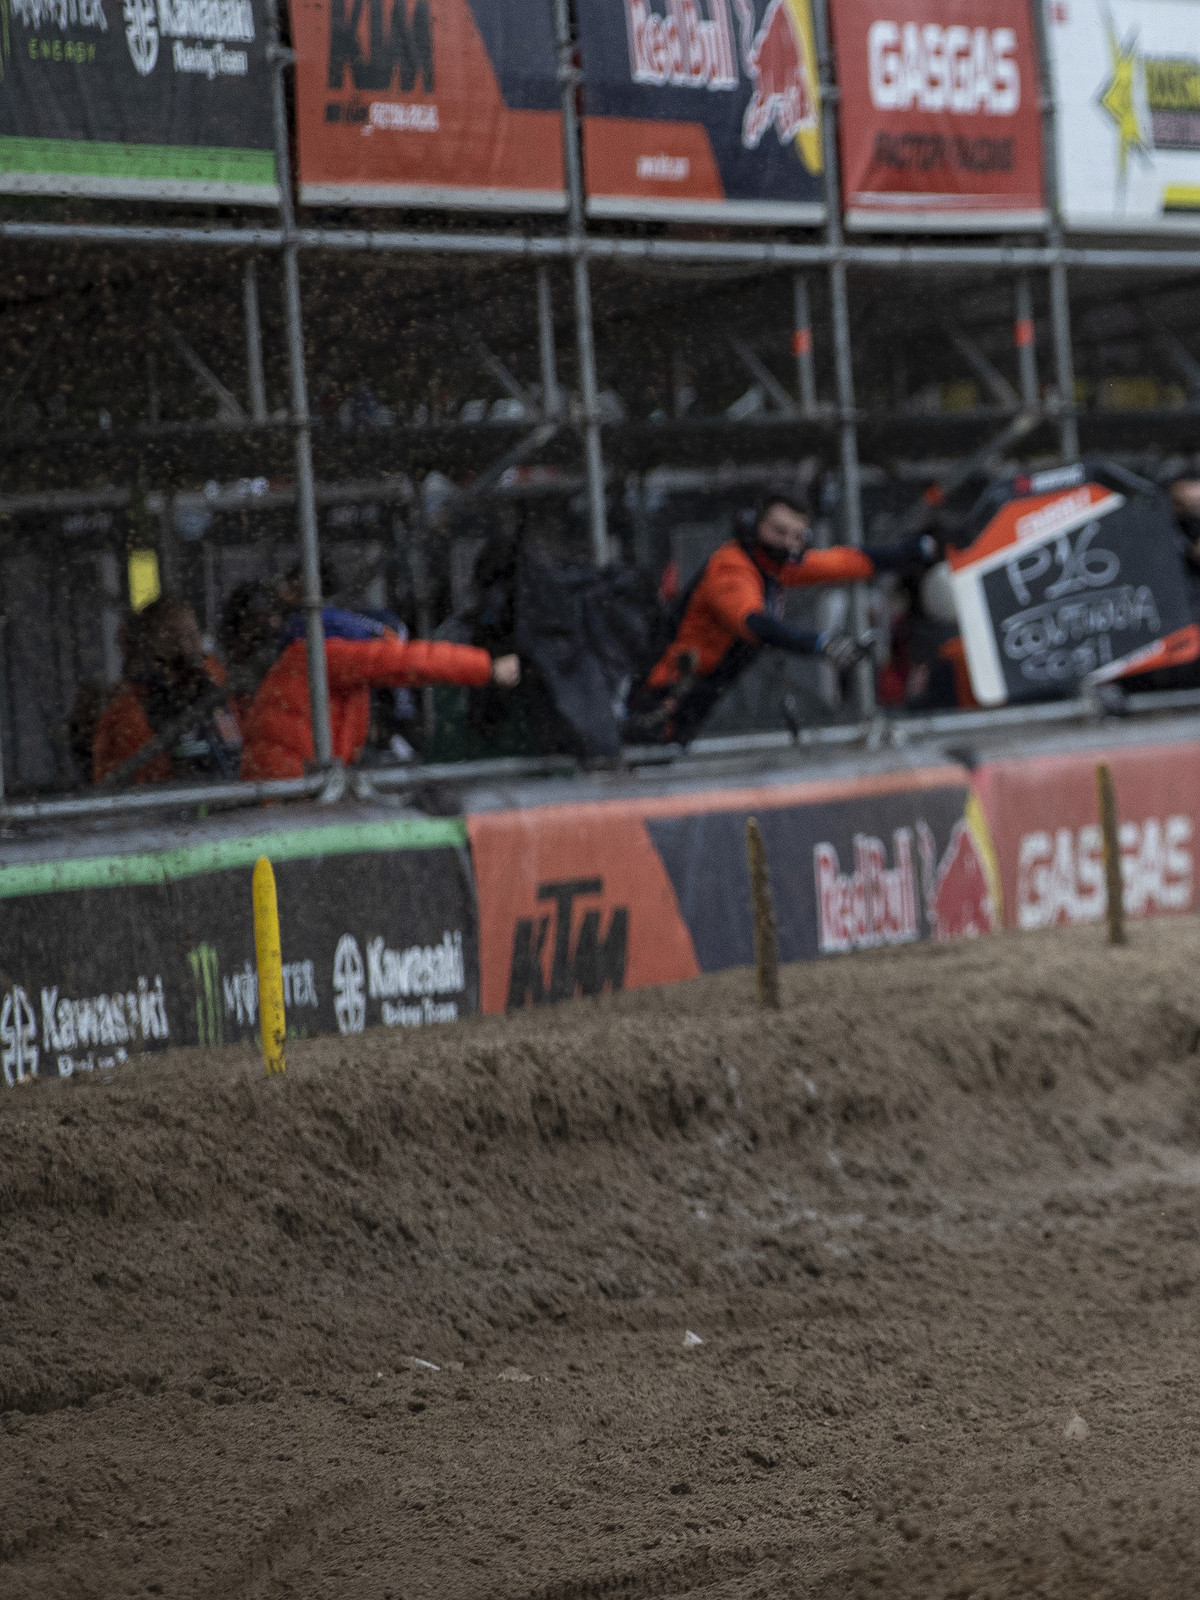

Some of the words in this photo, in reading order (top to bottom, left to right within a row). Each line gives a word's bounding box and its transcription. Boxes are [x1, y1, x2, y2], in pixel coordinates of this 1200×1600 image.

[28, 38, 96, 62] ENERGY
[327, 0, 435, 93] KTM
[867, 20, 1021, 116] GASGAS
[366, 929, 466, 999] Kawasaki
[505, 876, 630, 1008] KTM
